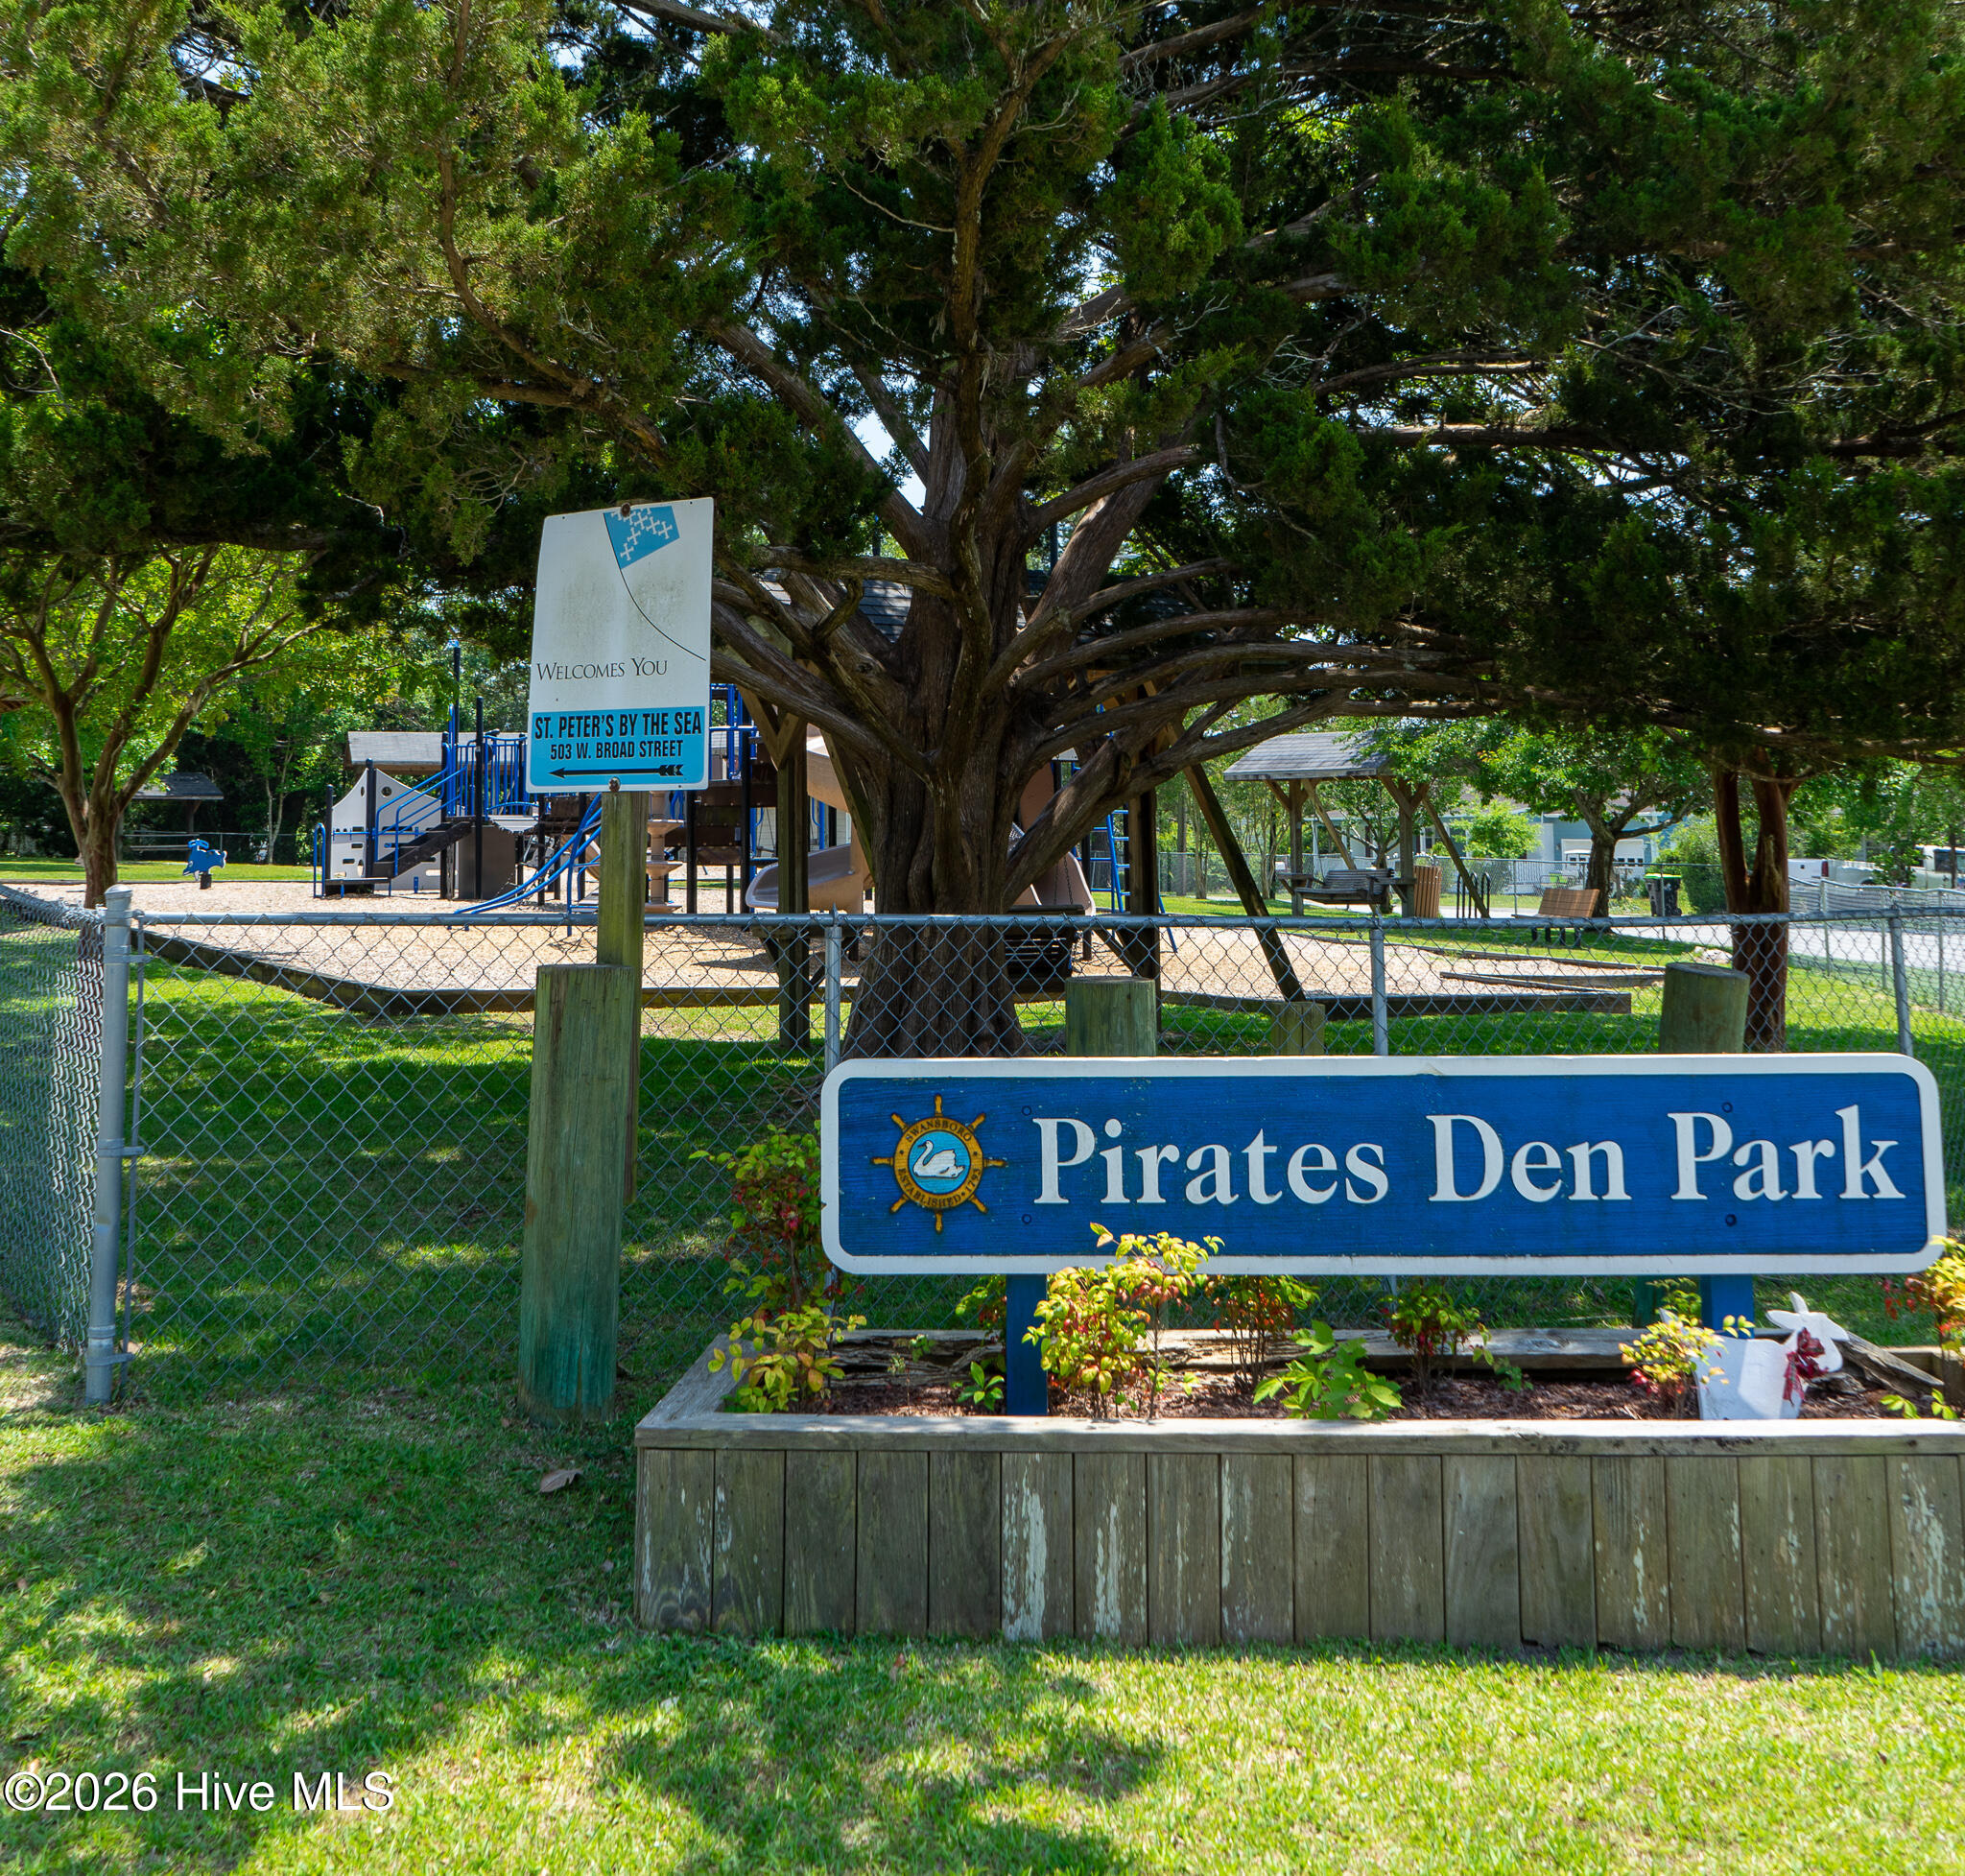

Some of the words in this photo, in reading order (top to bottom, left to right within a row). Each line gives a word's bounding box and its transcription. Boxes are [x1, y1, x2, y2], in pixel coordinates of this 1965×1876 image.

[534, 717, 554, 740] ST.
[558, 714, 614, 739] PETER'S
[619, 713, 638, 737] BY
[642, 712, 669, 736] THE
[674, 711, 702, 735] SEA
[550, 744, 573, 760] 503
[576, 743, 592, 759] W.
[596, 741, 635, 758] BROAD
[639, 740, 684, 758] STREET
[905, 1118, 973, 1143] SWANSBORO
[1031, 1117, 1390, 1205] Pirates
[1426, 1113, 1632, 1203] Den
[1667, 1104, 1907, 1202] Park
